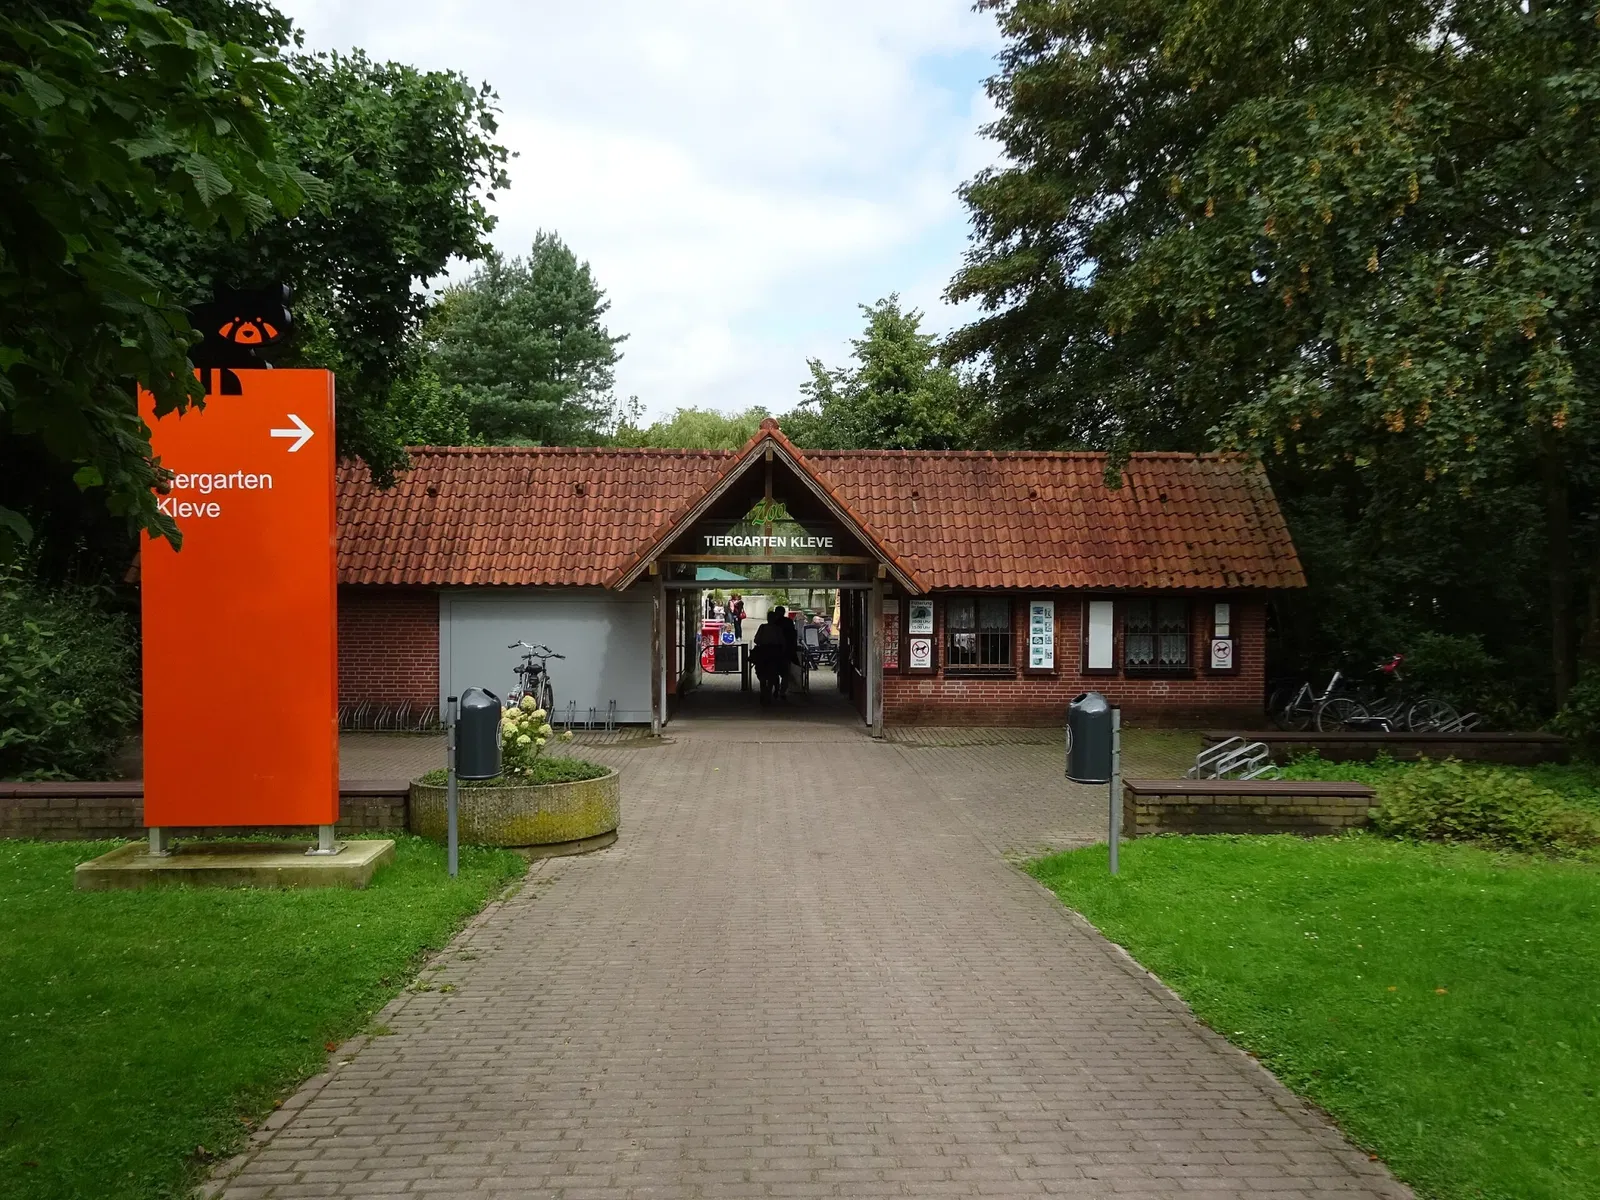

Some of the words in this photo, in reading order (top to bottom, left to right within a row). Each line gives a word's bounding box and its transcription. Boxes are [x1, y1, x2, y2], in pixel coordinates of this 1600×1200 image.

[156, 497, 221, 518] Kleve
[752, 501, 787, 526] Zoo
[704, 535, 787, 548] TIERGARTEN
[790, 536, 833, 548] KLEVE
